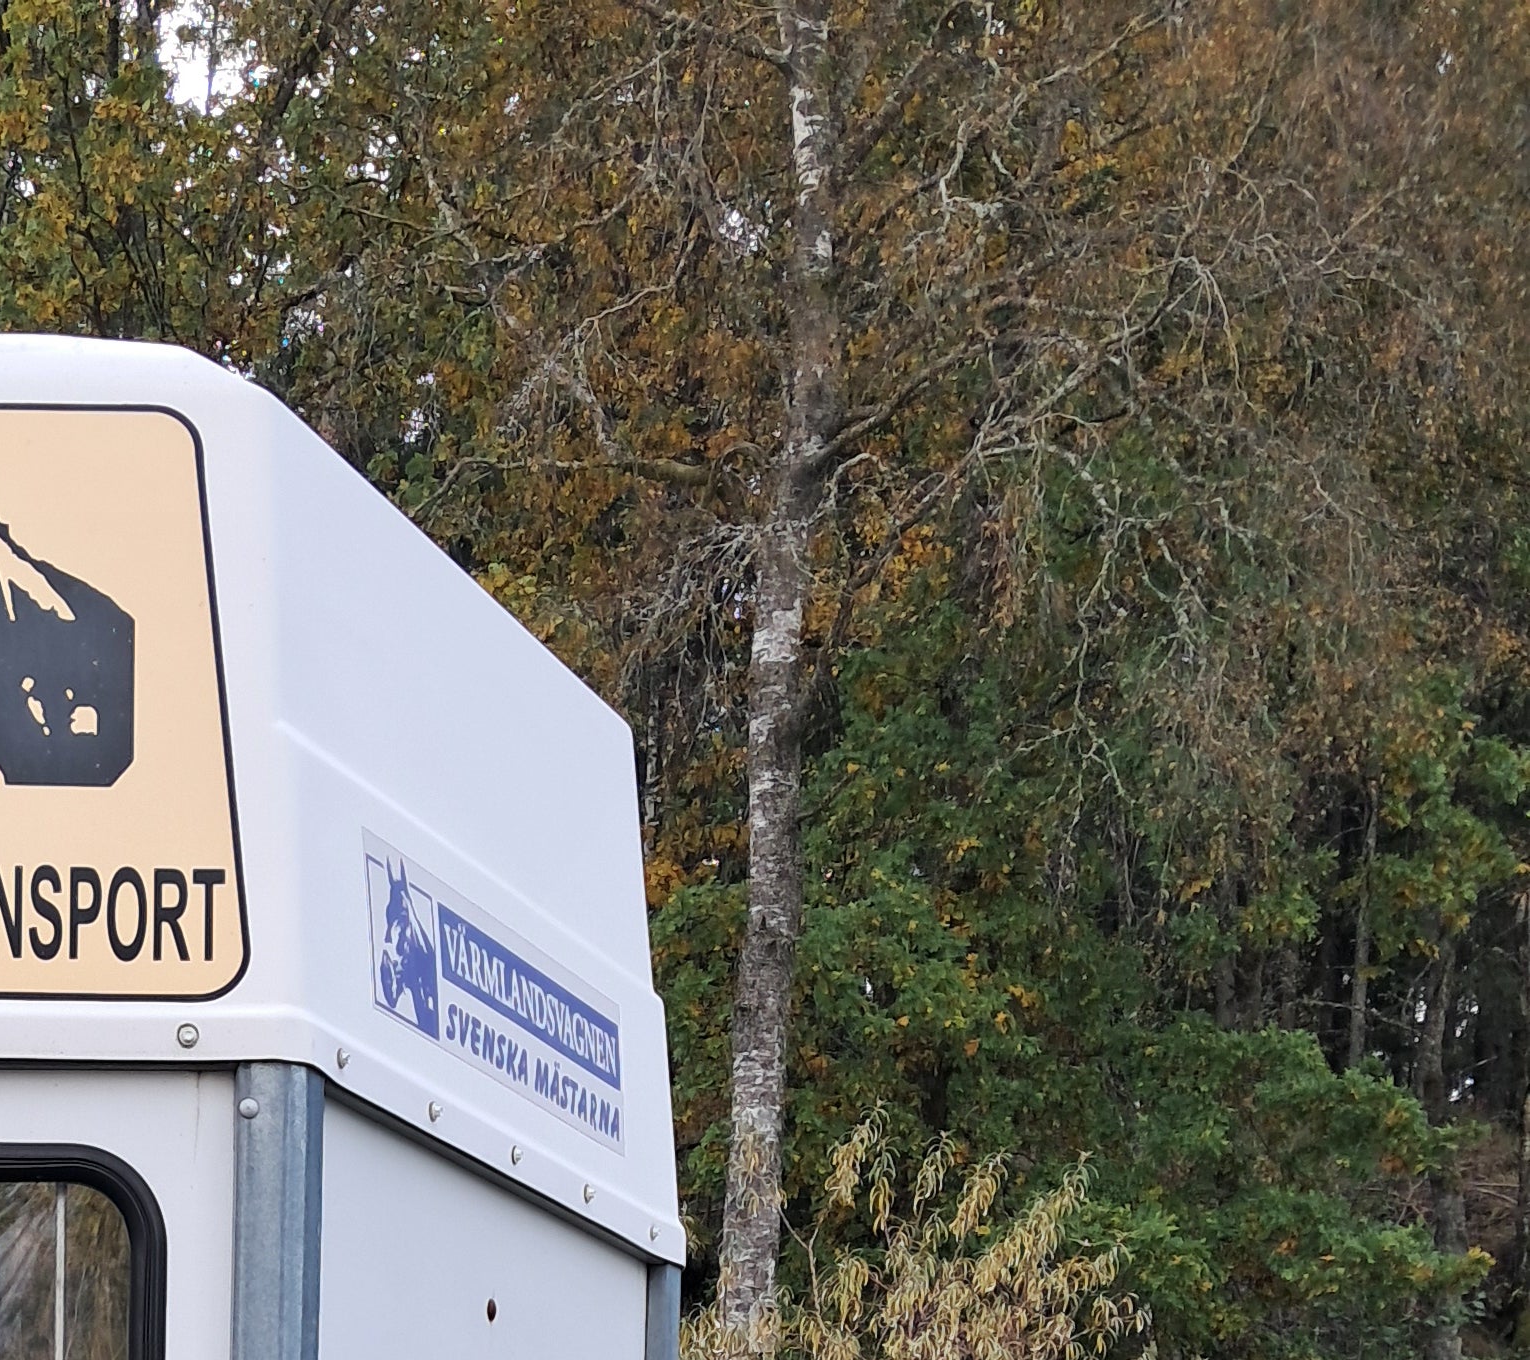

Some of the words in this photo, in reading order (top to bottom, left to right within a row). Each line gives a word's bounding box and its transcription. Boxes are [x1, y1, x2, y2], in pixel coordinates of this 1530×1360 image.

[443, 922, 619, 1078] VÄRMLANDSVAGNEN
[446, 1003, 528, 1086] SVENSKA
[534, 1058, 620, 1142] MÄSTARNA
